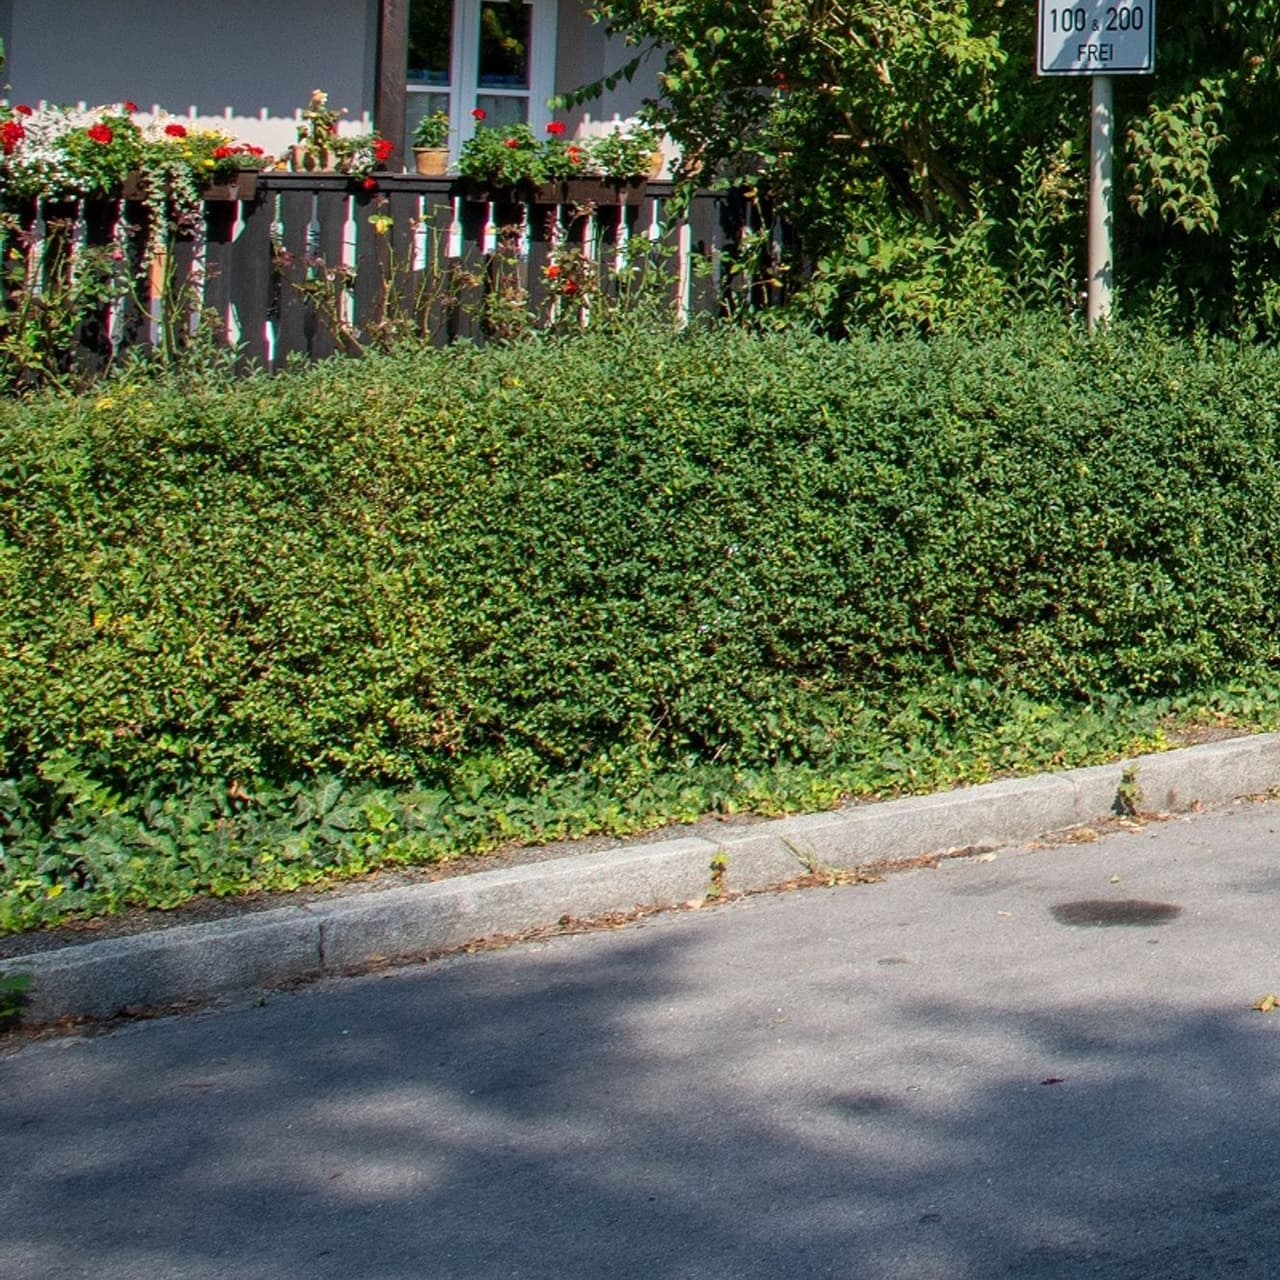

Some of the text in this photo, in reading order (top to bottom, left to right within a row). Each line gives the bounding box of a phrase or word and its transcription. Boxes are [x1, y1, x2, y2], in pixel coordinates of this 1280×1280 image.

[1050, 6, 1144, 32] 100 & 200
[1077, 43, 1114, 62] FREI
